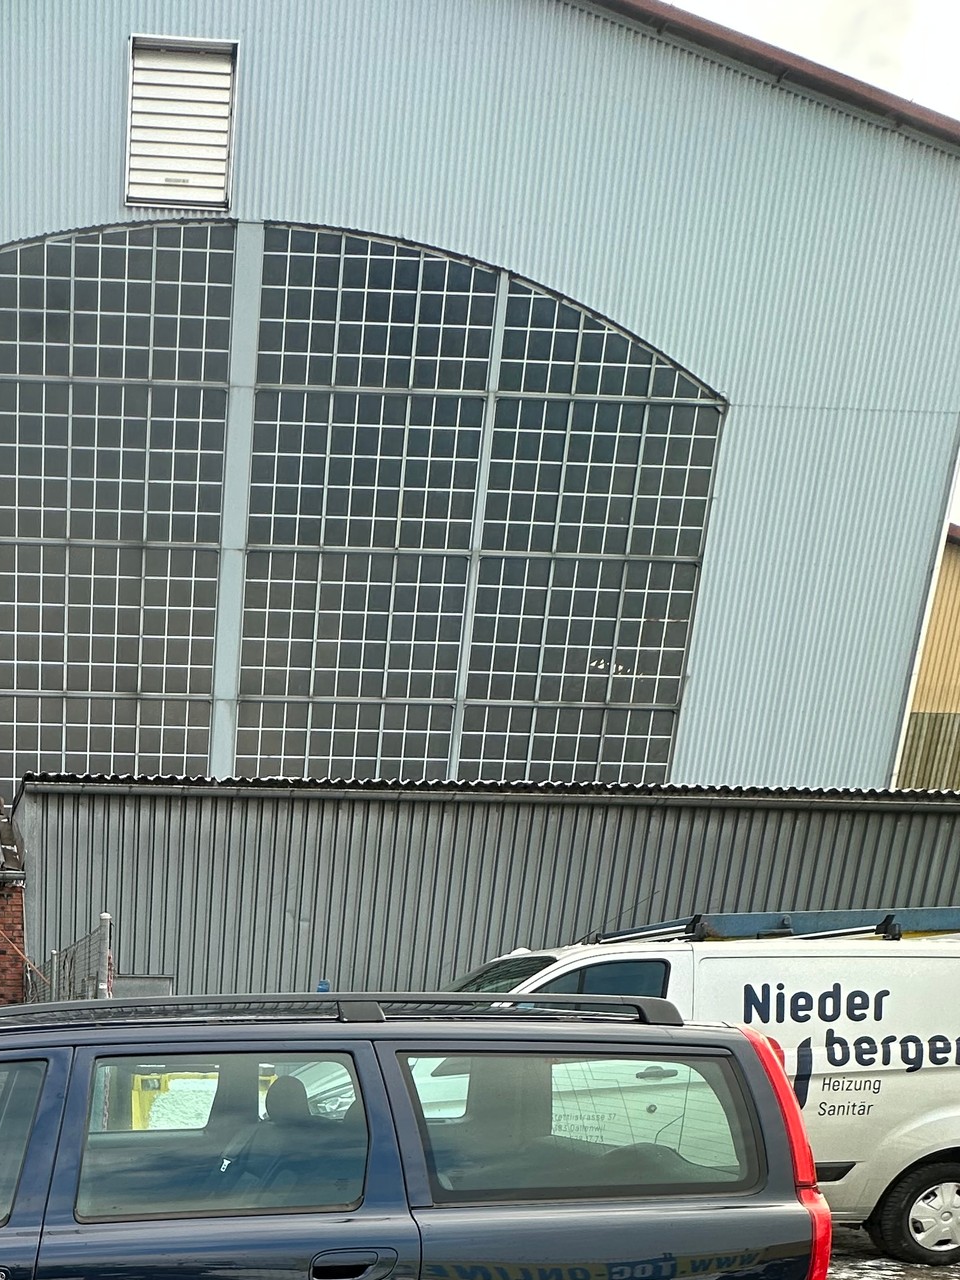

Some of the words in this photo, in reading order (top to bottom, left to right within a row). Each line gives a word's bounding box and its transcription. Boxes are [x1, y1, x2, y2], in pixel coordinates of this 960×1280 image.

[743, 982, 890, 1024] Nieder
[821, 1076, 882, 1094] Heizung
[817, 1101, 874, 1116] Sanitär
